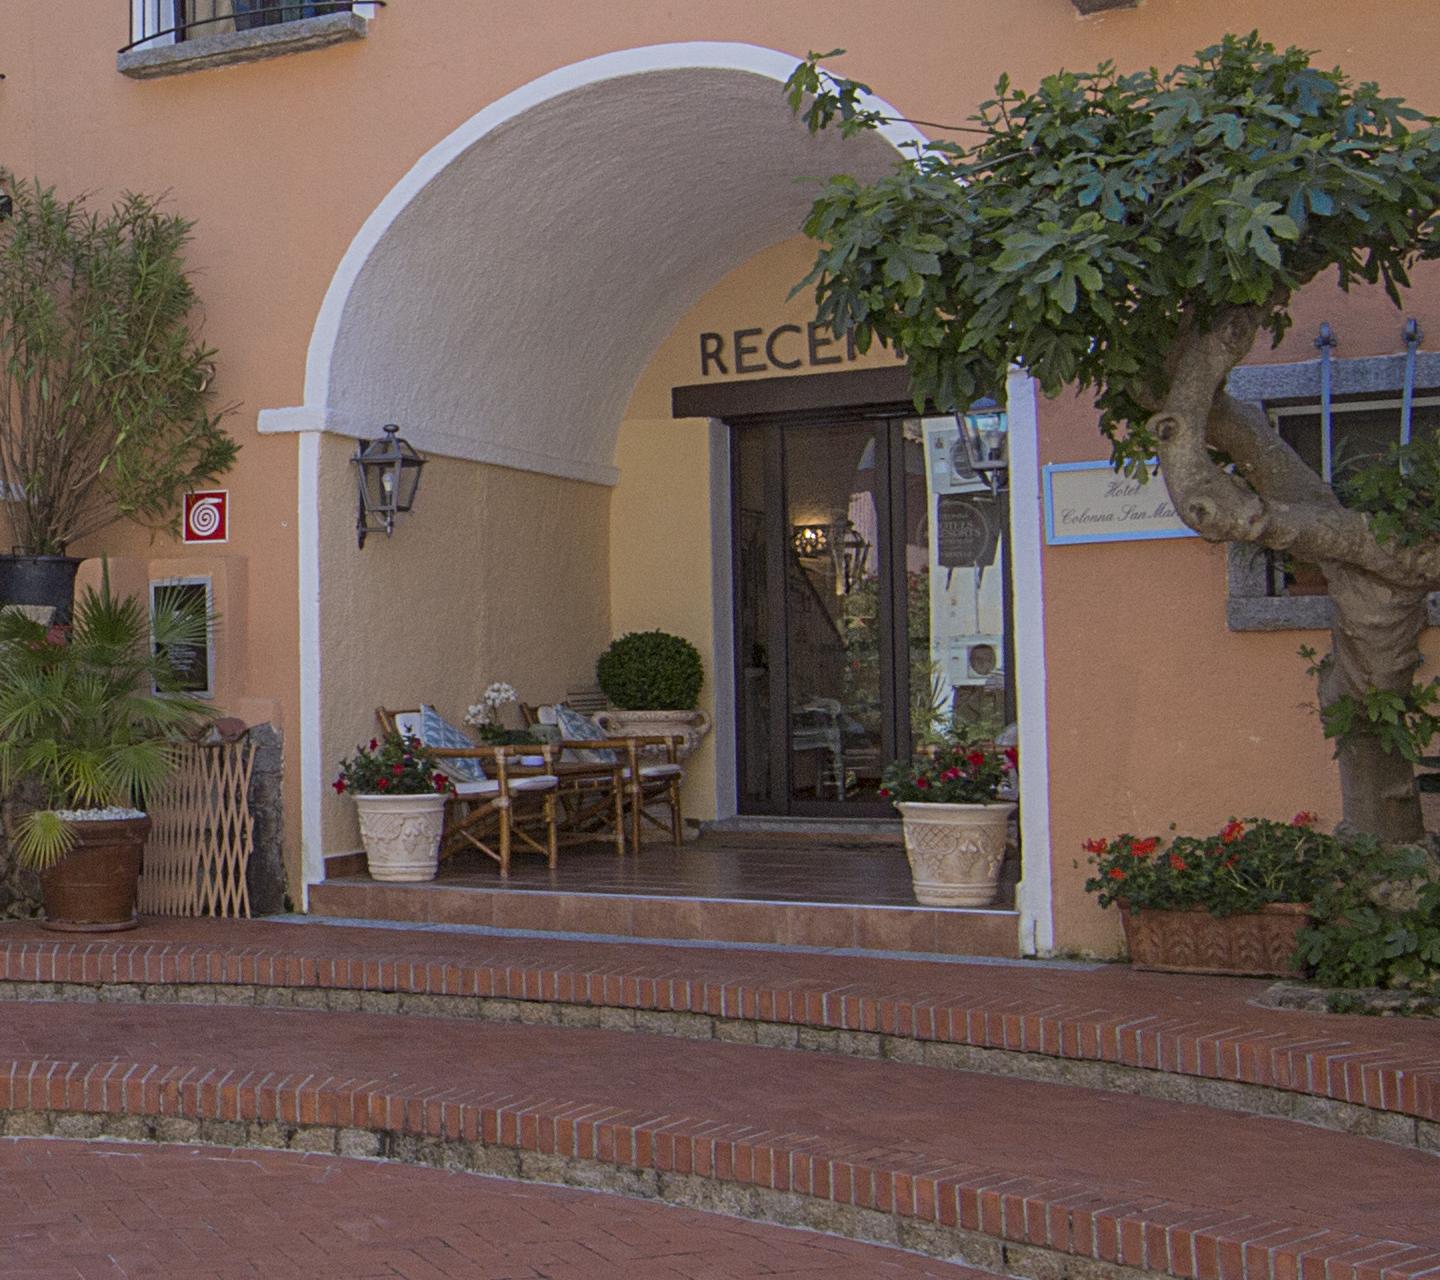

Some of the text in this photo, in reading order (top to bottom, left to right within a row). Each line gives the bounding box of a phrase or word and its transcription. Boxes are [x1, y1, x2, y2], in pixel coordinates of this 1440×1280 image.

[1105, 481, 1141, 498] Hotel
[1062, 502, 1178, 524] Colonna San Mar
